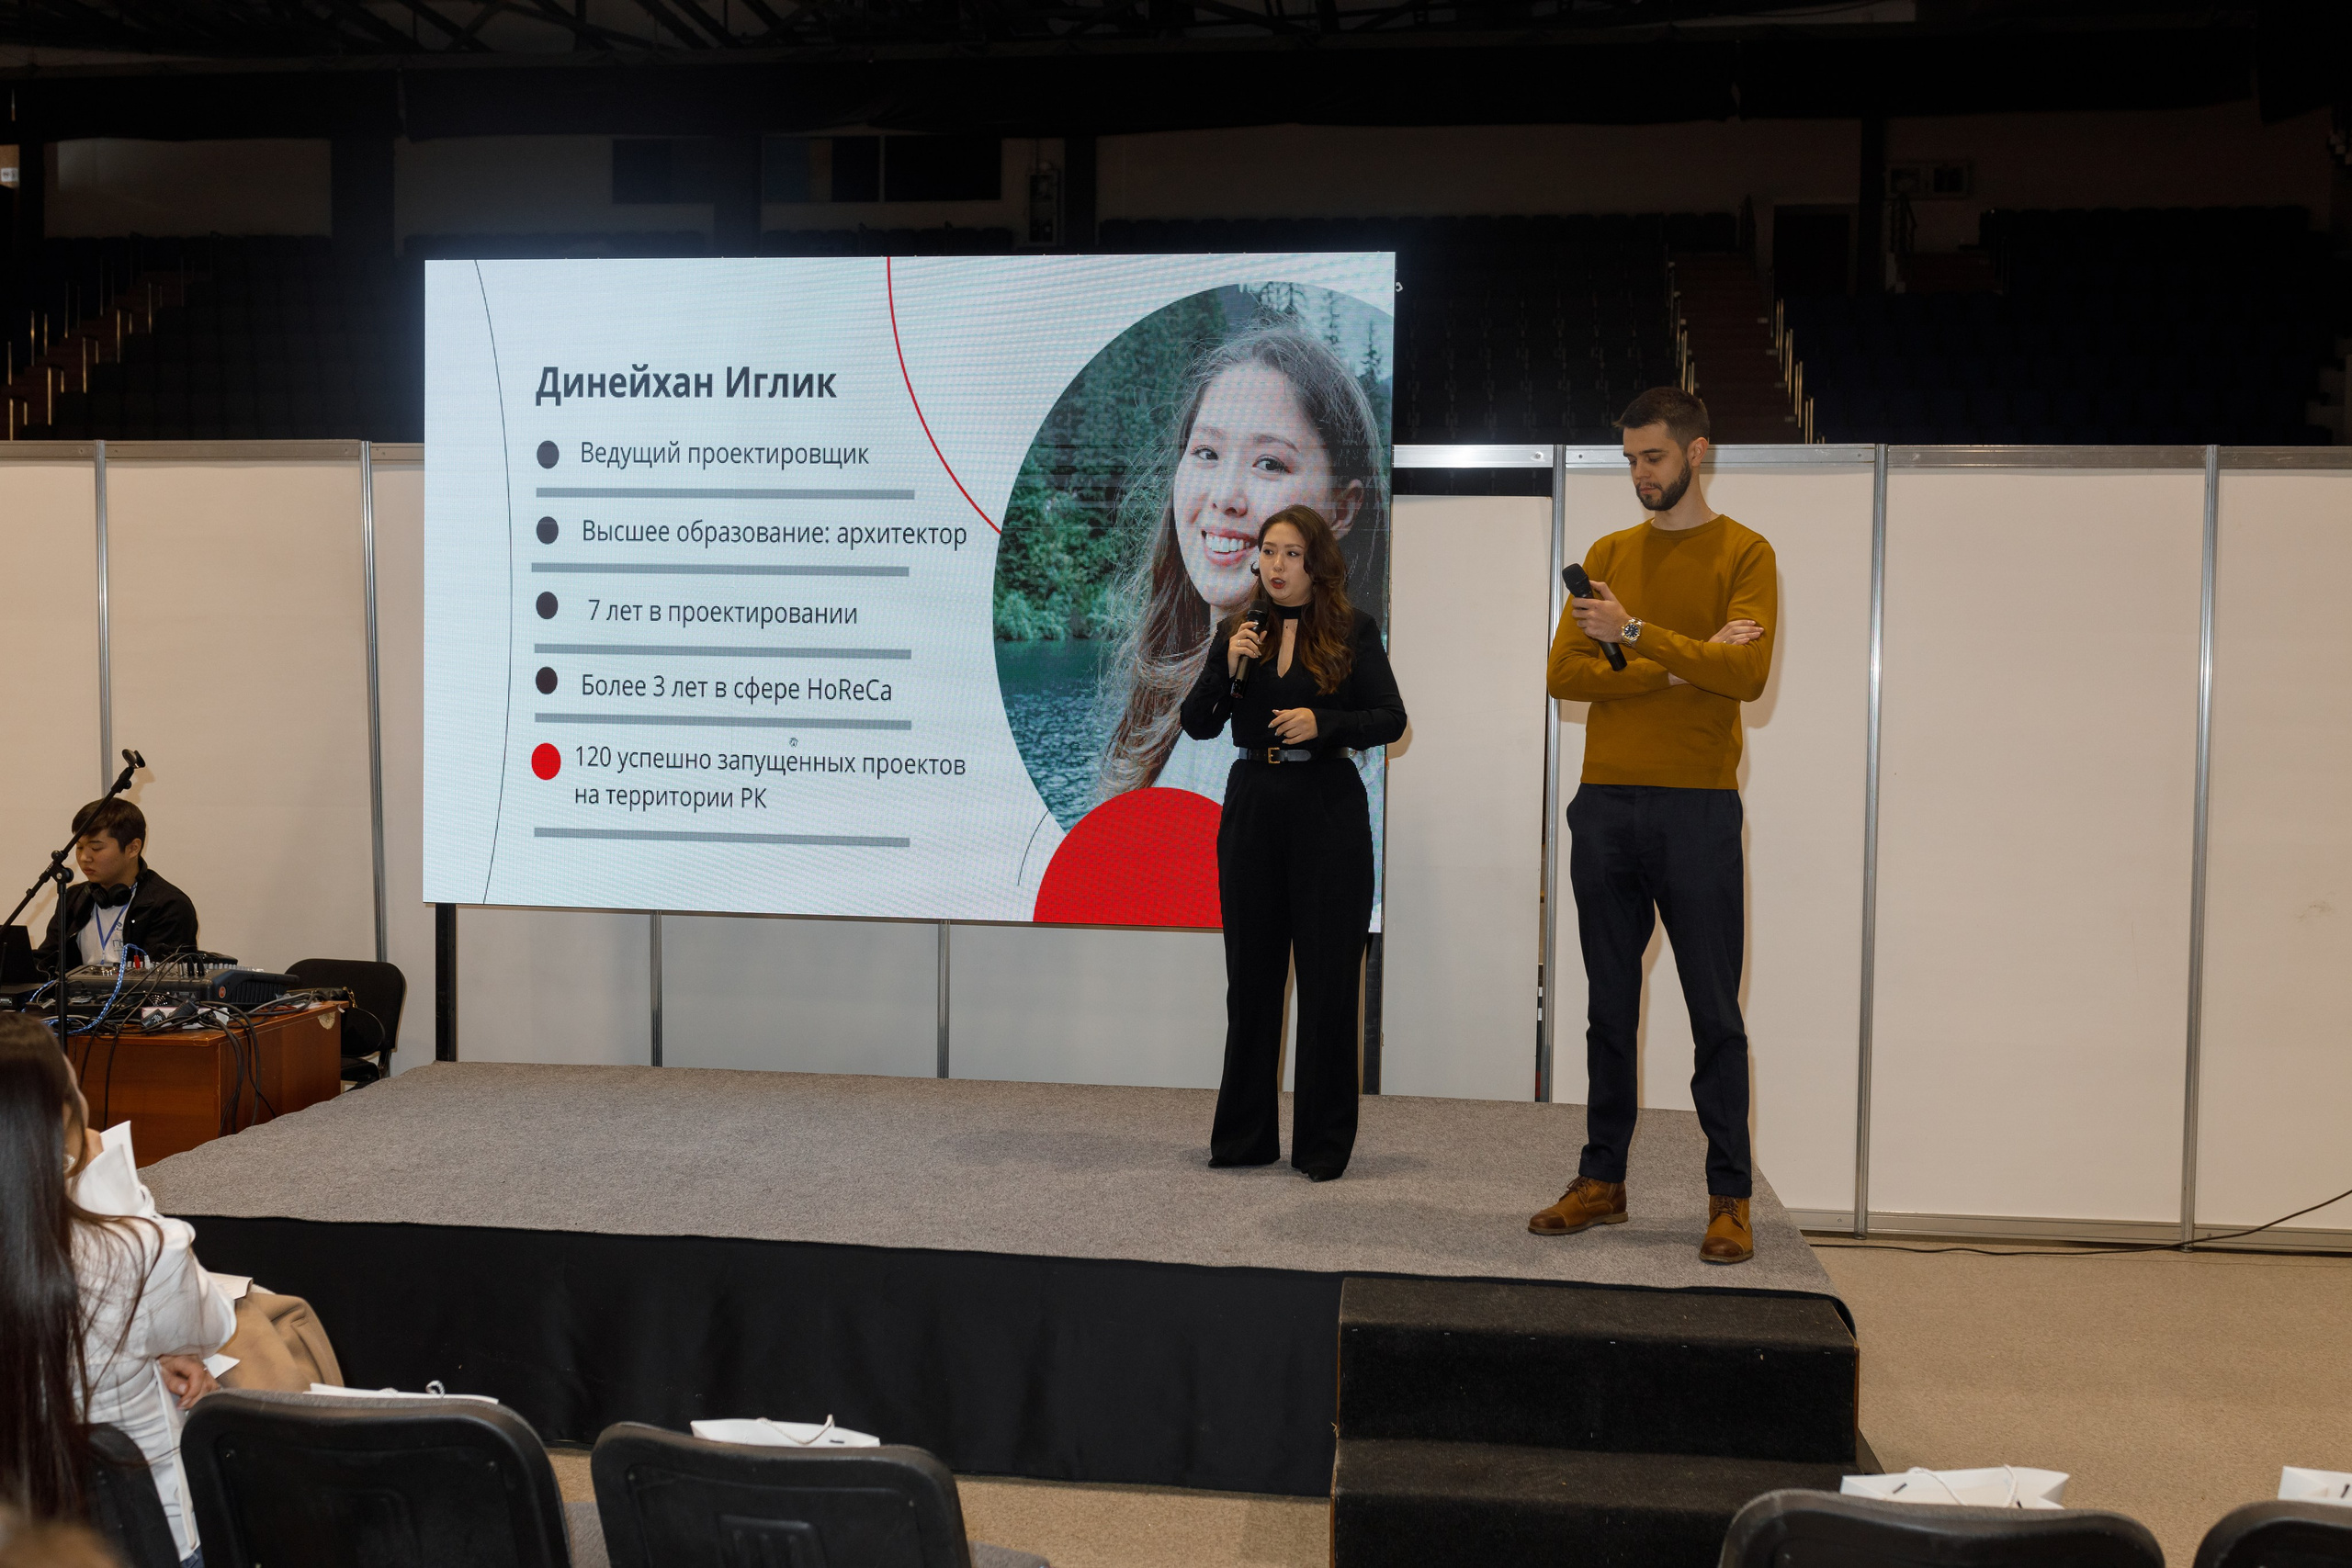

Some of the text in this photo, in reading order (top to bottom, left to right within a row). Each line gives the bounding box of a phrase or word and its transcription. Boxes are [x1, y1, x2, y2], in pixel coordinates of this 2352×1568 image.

[535, 363, 837, 407] Динейхан Иглик
[581, 440, 869, 471] Ведущий проектировщик
[582, 519, 967, 552] Высшее образование: архитектор
[588, 599, 857, 630] 7 лет в проектировании
[582, 673, 892, 706] Более 3 лет в сфере HoReCa
[576, 745, 967, 780] 120 успешно запущенных проектов
[575, 786, 767, 814] на территории РК
